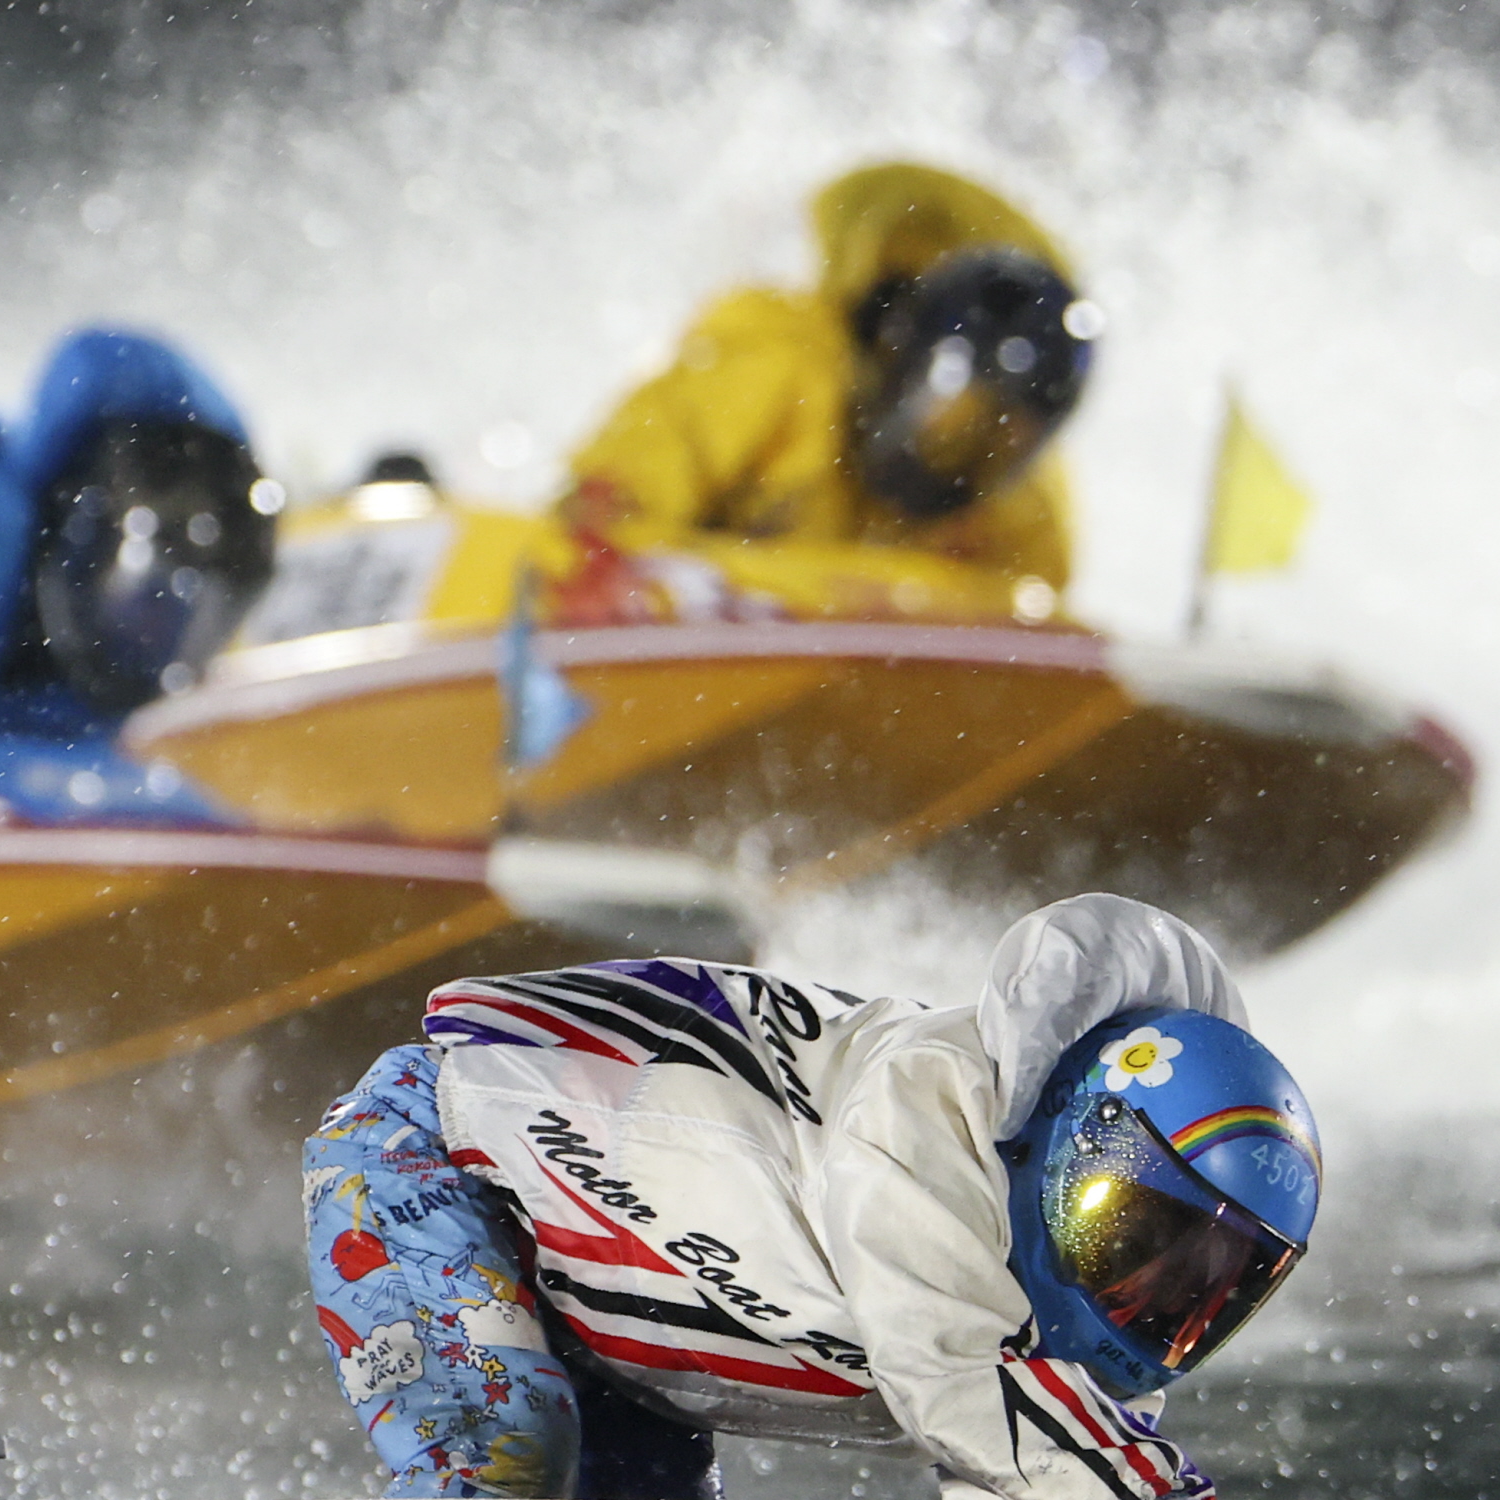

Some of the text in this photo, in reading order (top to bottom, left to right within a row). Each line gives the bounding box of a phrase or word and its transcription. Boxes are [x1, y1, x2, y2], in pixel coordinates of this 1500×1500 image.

[527, 1109, 658, 1225] Motor
[664, 1232, 792, 1322] Boat
[364, 1352, 415, 1390] WAVES
